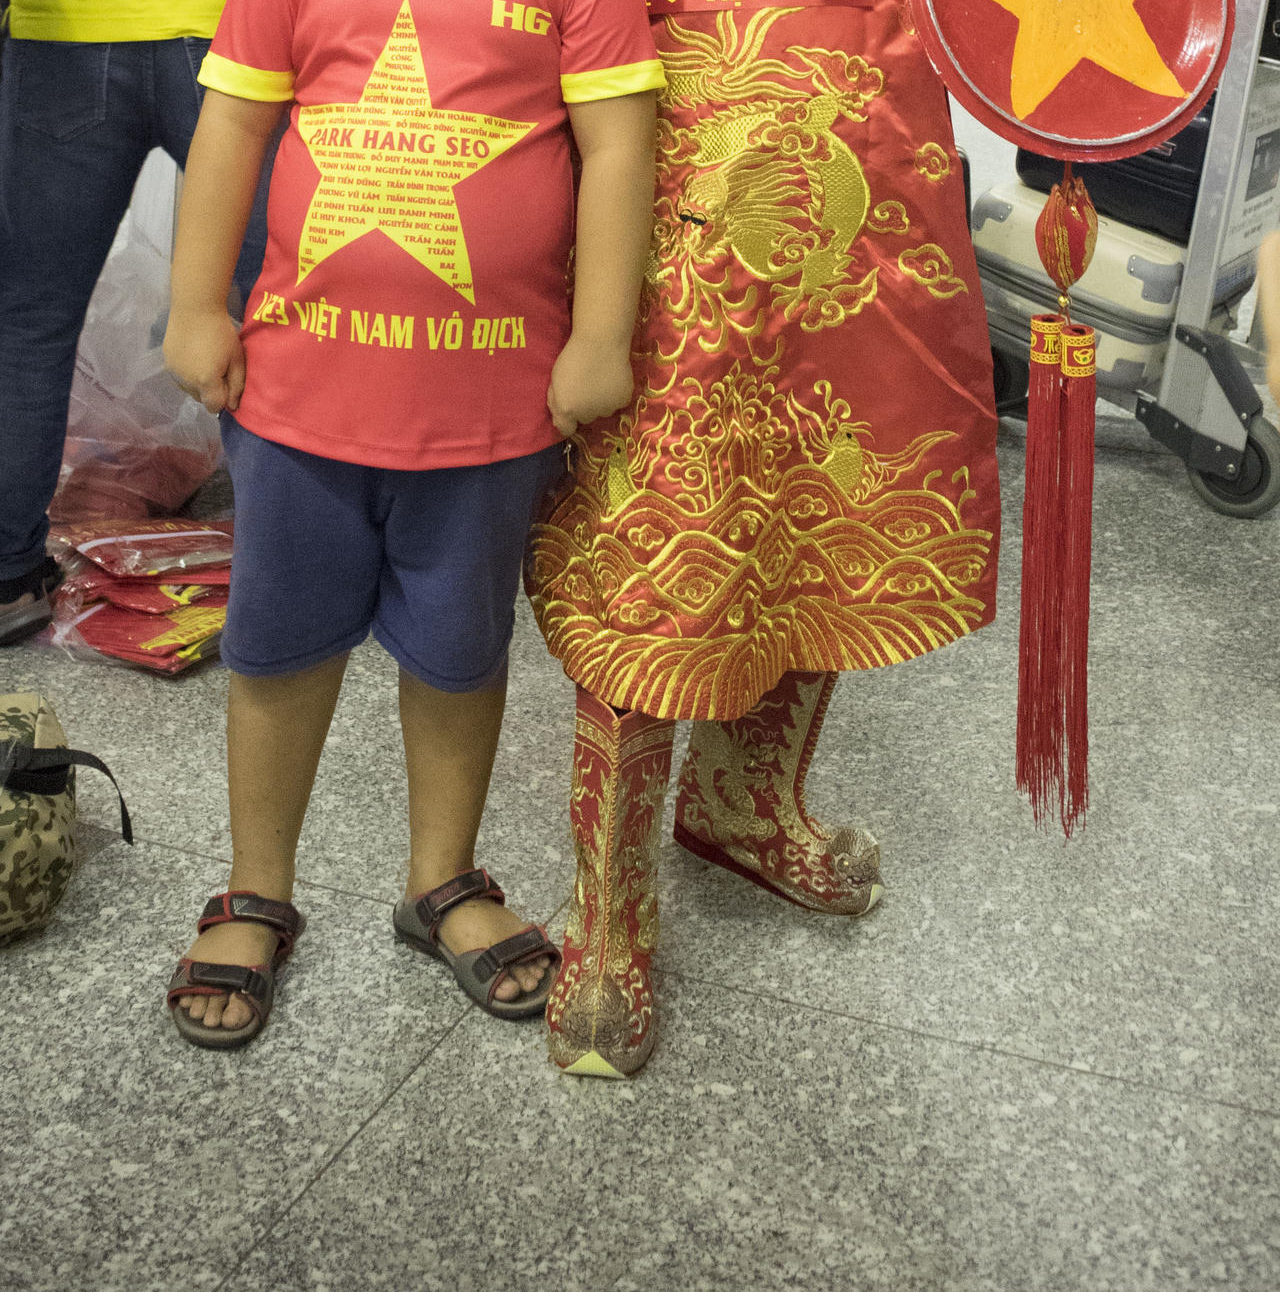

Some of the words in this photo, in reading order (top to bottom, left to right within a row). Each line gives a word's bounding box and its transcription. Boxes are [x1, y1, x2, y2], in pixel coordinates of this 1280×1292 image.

[309, 127, 356, 148] PARK
[362, 129, 435, 154] HANG
[446, 136, 490, 159] SEO
[338, 215, 366, 225] KHOA
[293, 297, 342, 342] VIỆT
[350, 310, 415, 349] NAM
[426, 310, 464, 350] VÔ
[471, 316, 527, 355] ĐỊCH
